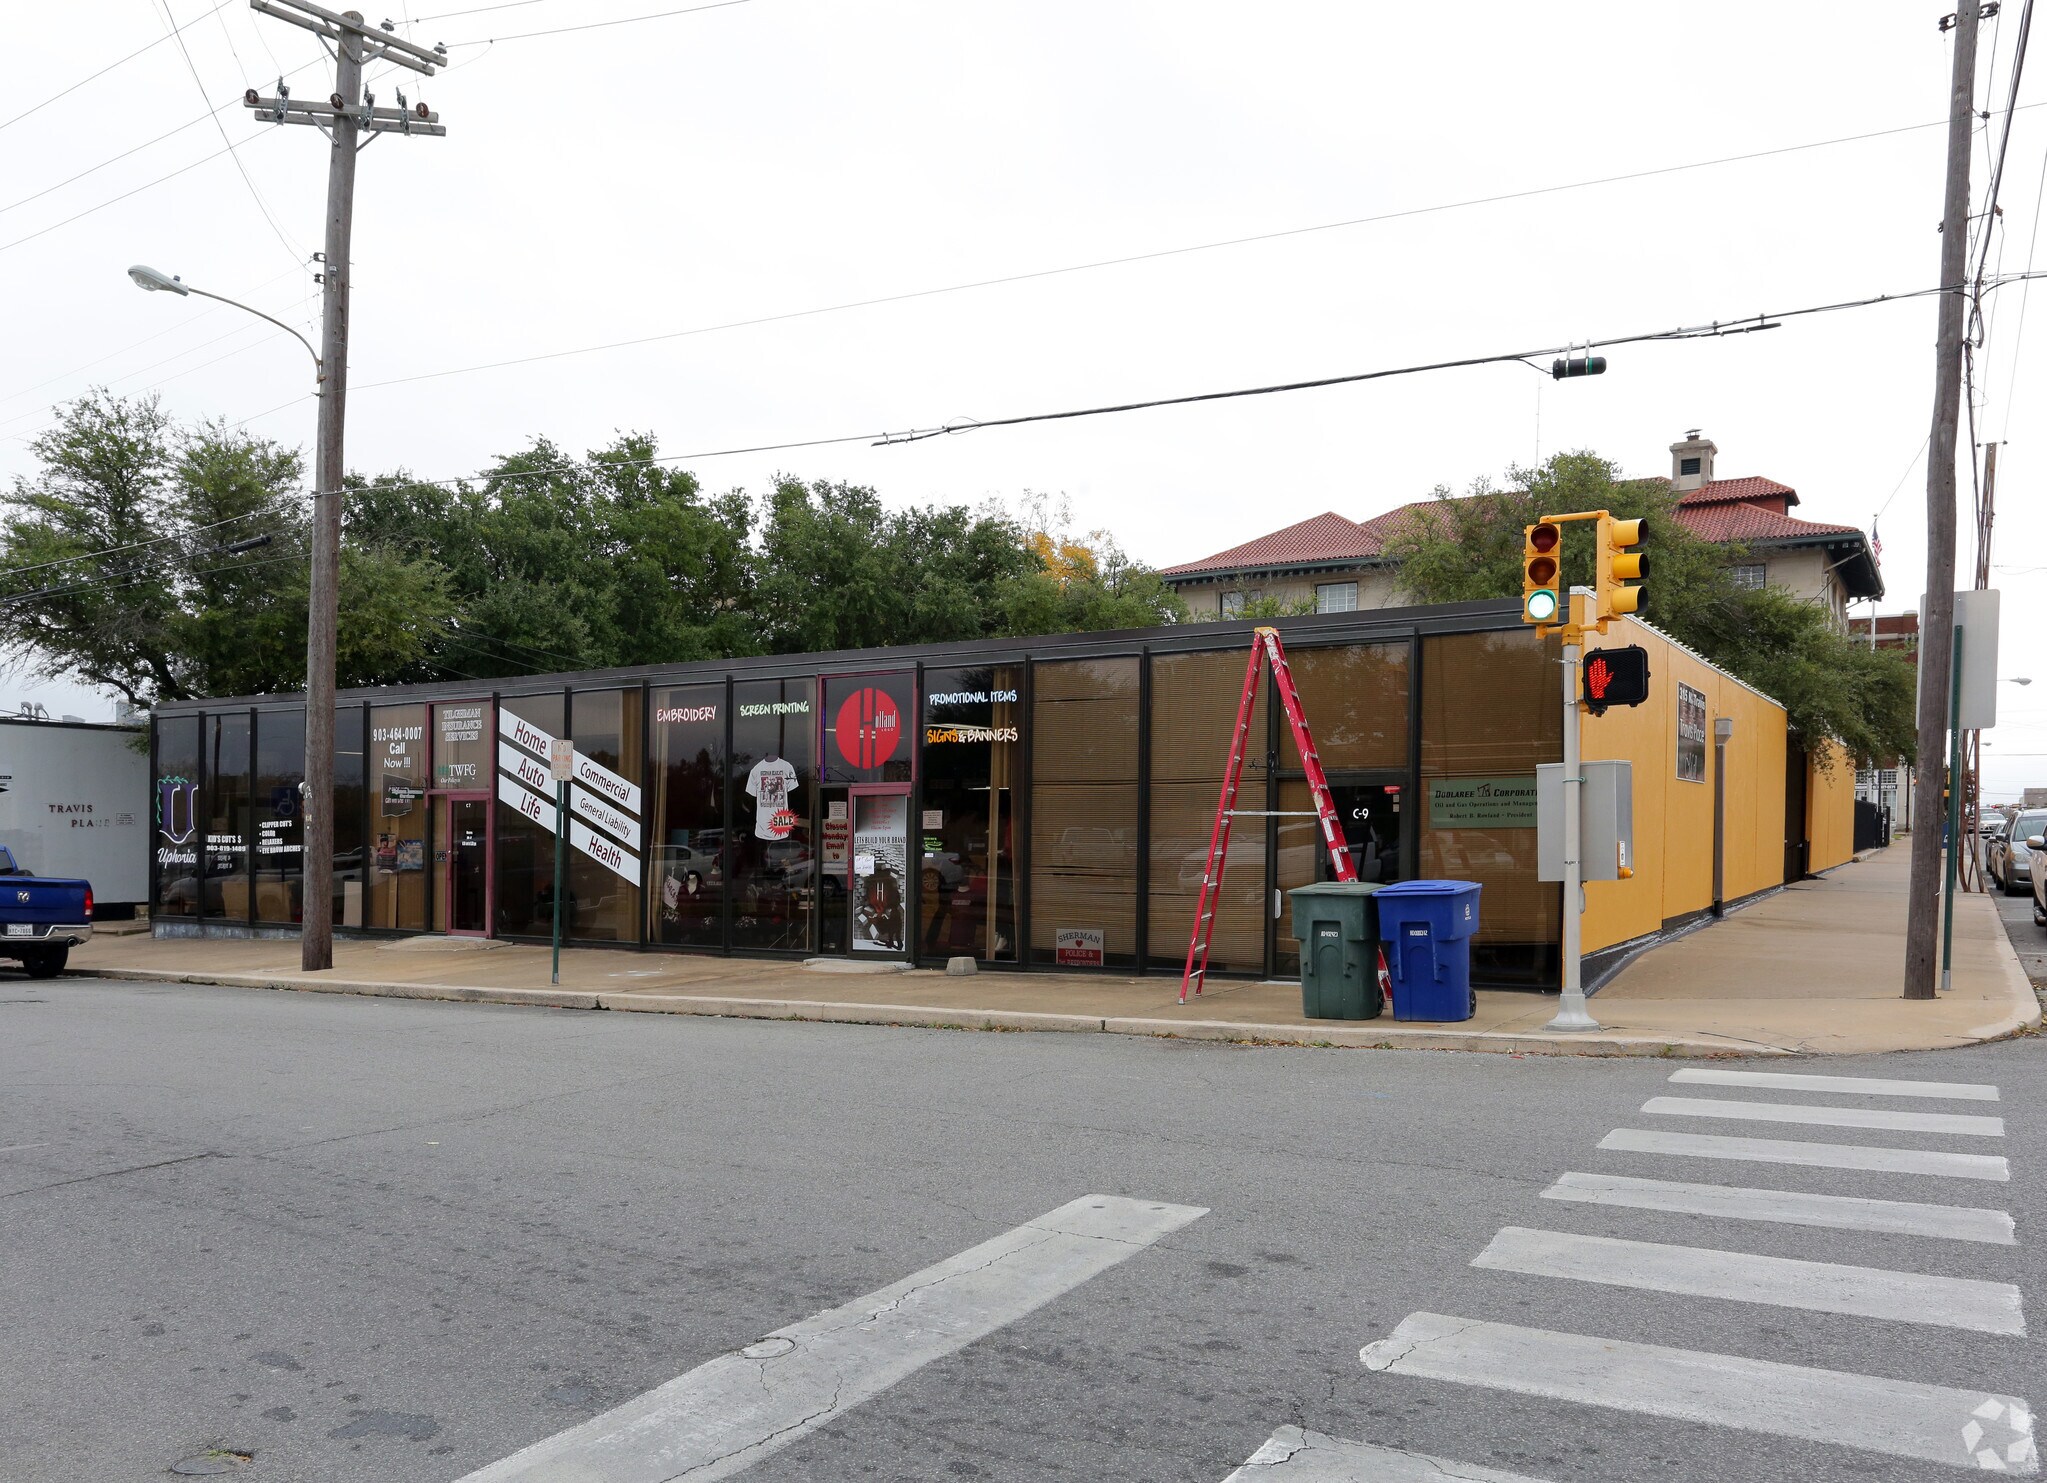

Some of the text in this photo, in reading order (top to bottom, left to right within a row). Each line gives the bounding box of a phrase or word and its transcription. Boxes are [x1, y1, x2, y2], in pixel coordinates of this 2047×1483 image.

[929, 689, 1018, 706] PROMOTIONAL ITEMS
[656, 705, 717, 723] EMBROIDERY
[739, 701, 810, 717] SCREEN PRINTING
[441, 720, 483, 731] INSURANCE
[1680, 718, 1704, 743] Travis Place
[373, 726, 423, 742] 903-464-0007
[444, 730, 479, 742] SERVICES
[514, 720, 547, 755] Home
[926, 728, 959, 744] SIGNS
[967, 727, 1018, 743] BANNERS
[389, 742, 406, 755] Call
[383, 757, 402, 768] Now
[448, 764, 476, 777] TWFG
[517, 757, 545, 788] Auto
[580, 762, 631, 802] Commercial
[49, 804, 94, 813] TRAVIS
[520, 792, 541, 820] Life
[580, 797, 632, 839] General Liability
[1352, 808, 1369, 820] C-9
[773, 816, 794, 827] SALE
[825, 822, 848, 831] Closed
[588, 835, 622, 870] Health
[826, 842, 845, 850] Email
[157, 847, 198, 869] Uphoria
[832, 852, 840, 860] to
[1058, 932, 1101, 944] SHERMAN
[1066, 950, 1087, 958] POLICE
